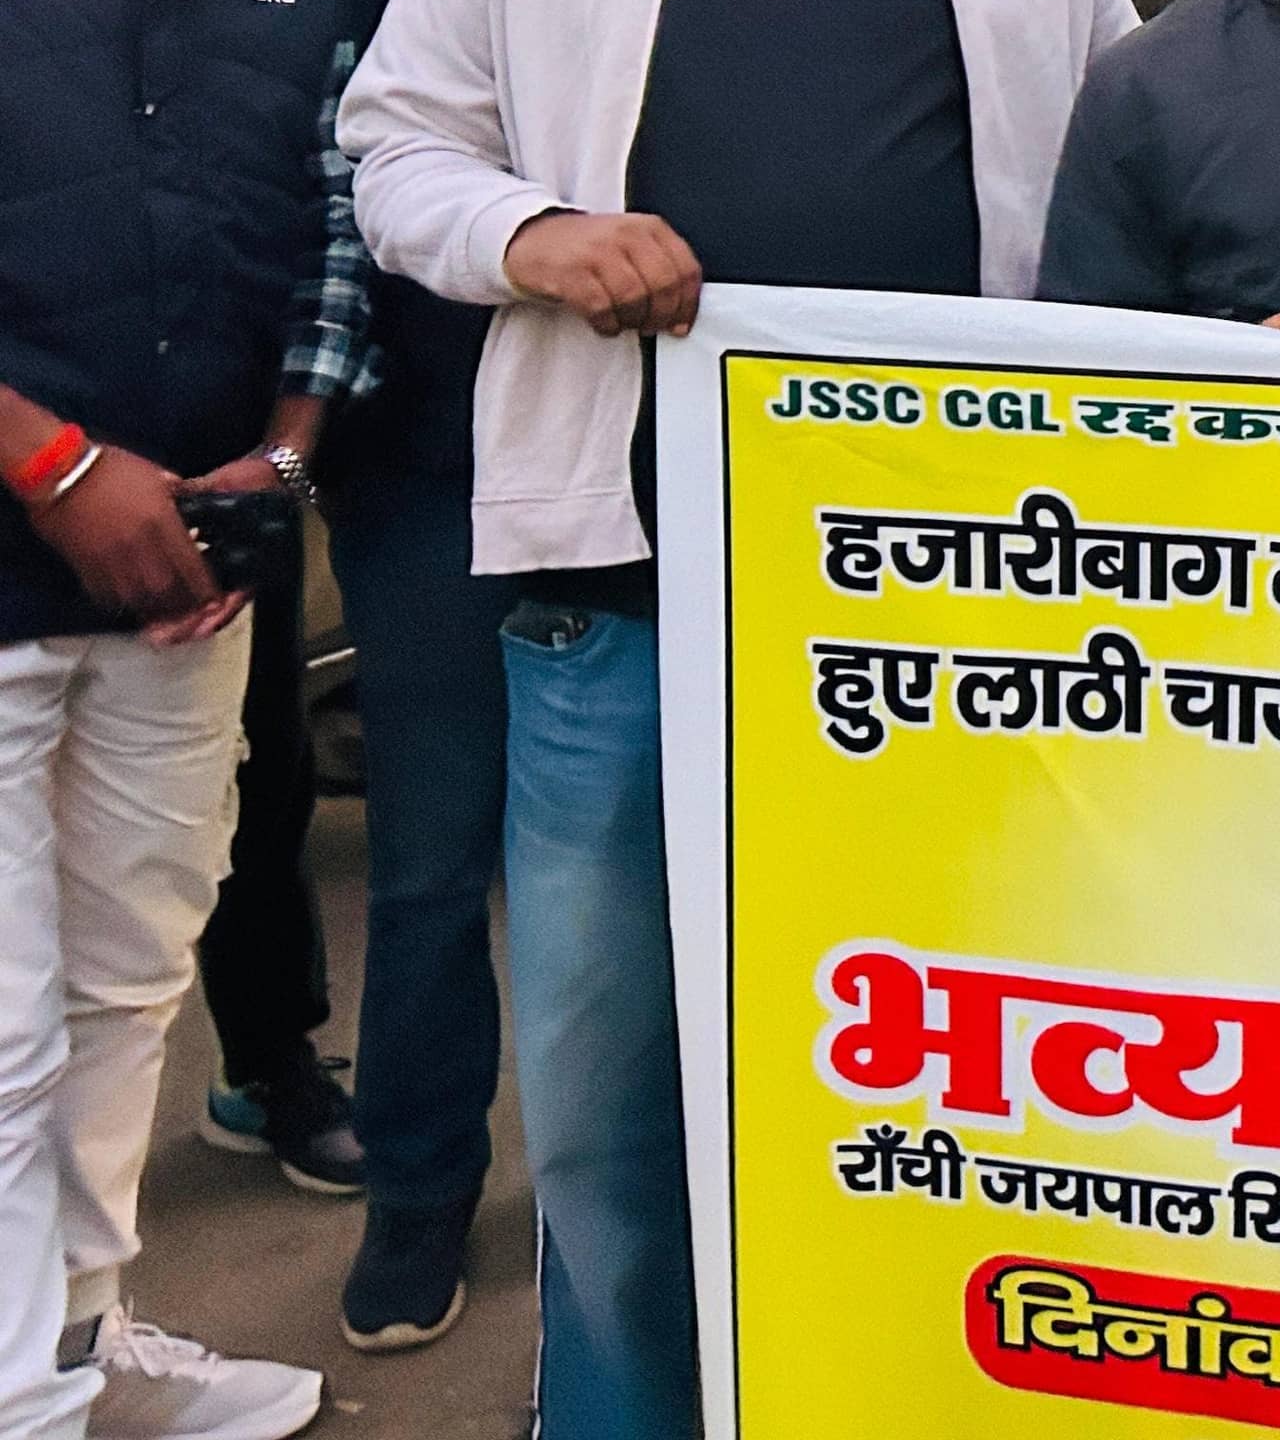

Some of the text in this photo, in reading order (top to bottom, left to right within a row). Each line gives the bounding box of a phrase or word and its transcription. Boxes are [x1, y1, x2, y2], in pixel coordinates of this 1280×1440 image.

[772, 380, 919, 423] JSSC
[946, 390, 1059, 432] CGL
[1078, 401, 1174, 441] रद्द
[821, 494, 1256, 608] हजारीबाग
[813, 644, 939, 753] हुए
[953, 633, 1150, 733] लाठी
[837, 1125, 966, 1199] राँची
[975, 1158, 1221, 1235] जयपाल
